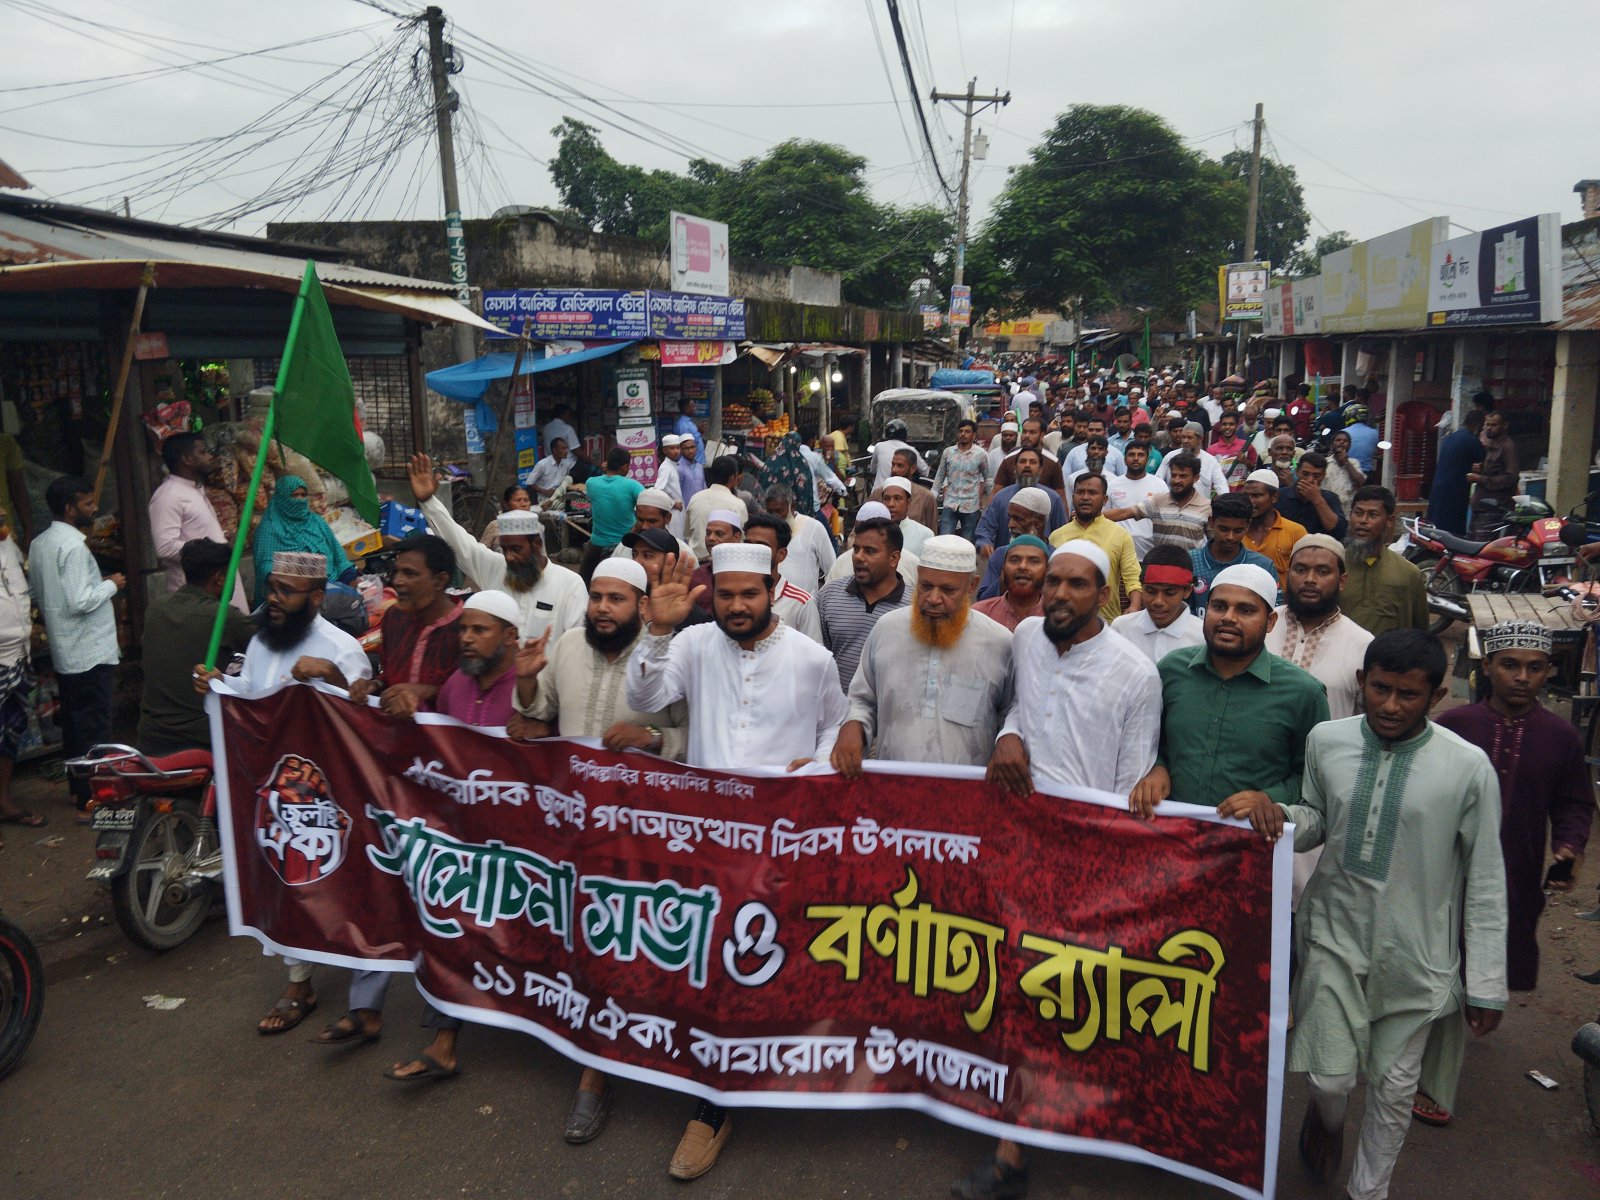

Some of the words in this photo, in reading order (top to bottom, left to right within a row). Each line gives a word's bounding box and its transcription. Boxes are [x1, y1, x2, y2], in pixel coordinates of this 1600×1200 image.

[484, 294, 517, 312] মেসার্স
[519, 291, 557, 312] আলিফ
[650, 296, 673, 313] মেসার্স
[673, 294, 697, 314] আলিফ
[534, 785, 587, 831] জুলাই
[771, 817, 846, 862] দিবস
[851, 815, 982, 865] উপলক্ষে
[365, 802, 577, 953] আলোচনা
[579, 874, 722, 989] সভা
[722, 899, 787, 989] ও
[804, 865, 1006, 1034] বর্ণাঢ্য
[472, 960, 517, 996] ১১
[523, 970, 591, 1031] দলীয়
[688, 1026, 858, 1077] কাহারোল
[864, 1025, 1009, 1104] উপজেলা
